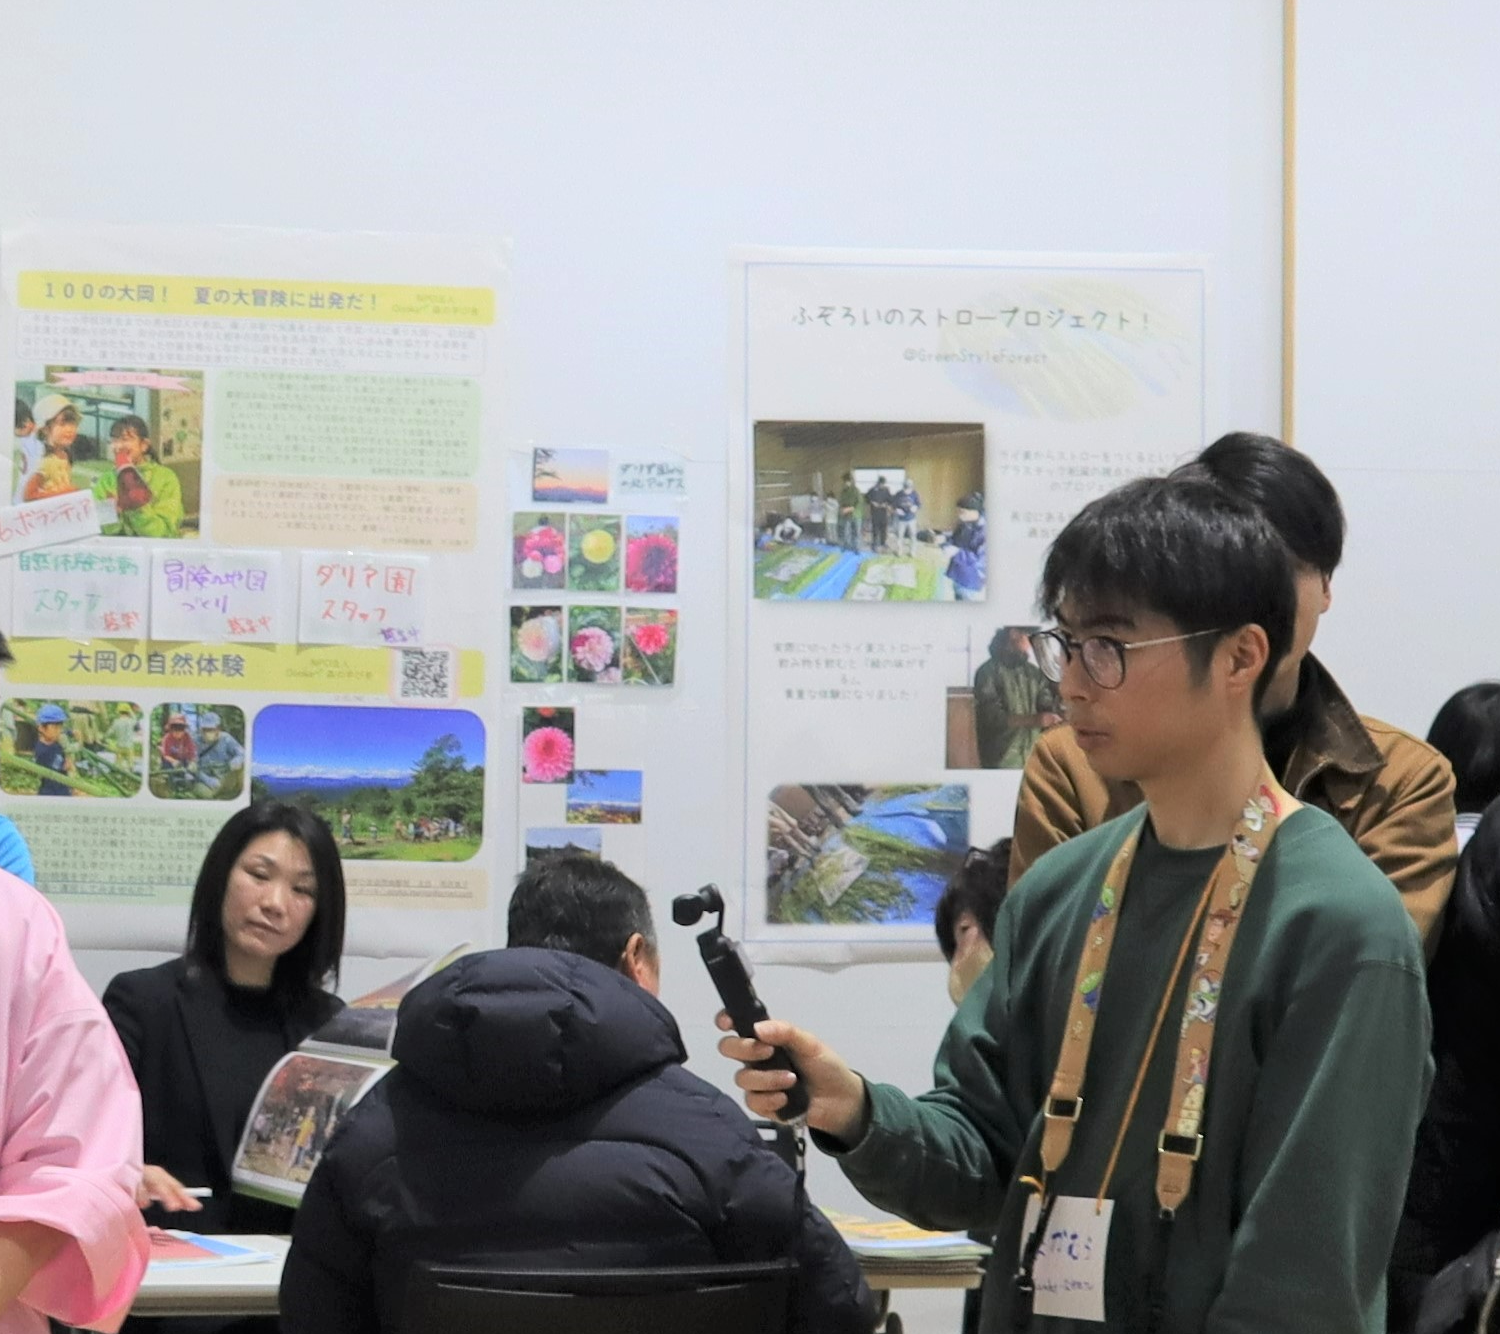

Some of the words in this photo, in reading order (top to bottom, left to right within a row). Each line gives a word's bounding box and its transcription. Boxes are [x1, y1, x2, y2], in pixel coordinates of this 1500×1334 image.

[194, 285, 379, 312] 夏の大冒険に出発だ！
[67, 649, 246, 678] 大岡の自然体験
